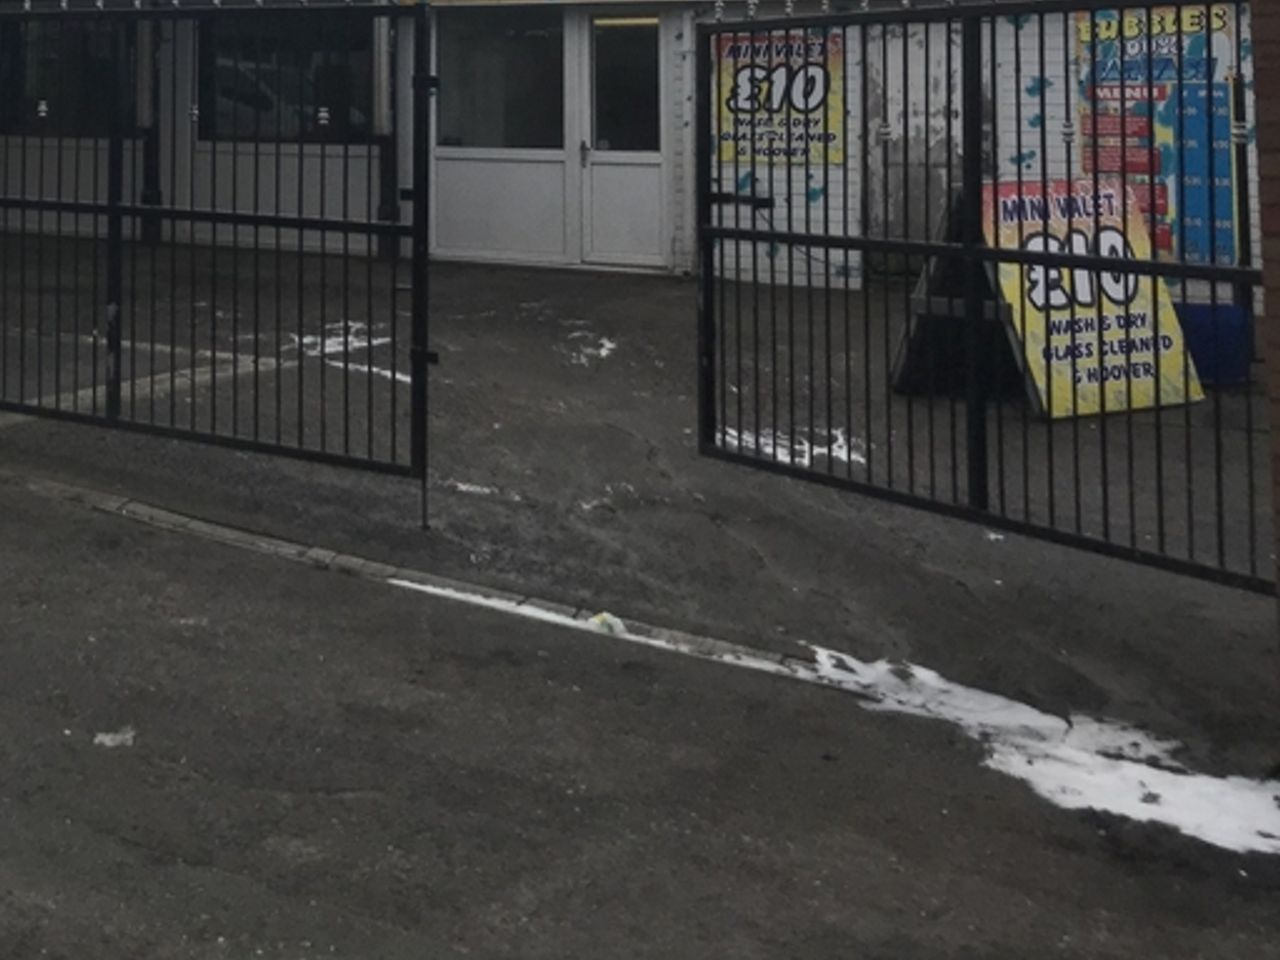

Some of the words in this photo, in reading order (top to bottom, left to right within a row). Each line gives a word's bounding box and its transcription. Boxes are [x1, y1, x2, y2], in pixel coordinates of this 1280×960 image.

[726, 62, 831, 114] £10
[1055, 192, 1115, 219] VALET
[1023, 225, 1139, 312] £10
[1049, 316, 1096, 337] WASH
[1098, 334, 1174, 357] CLEAND
